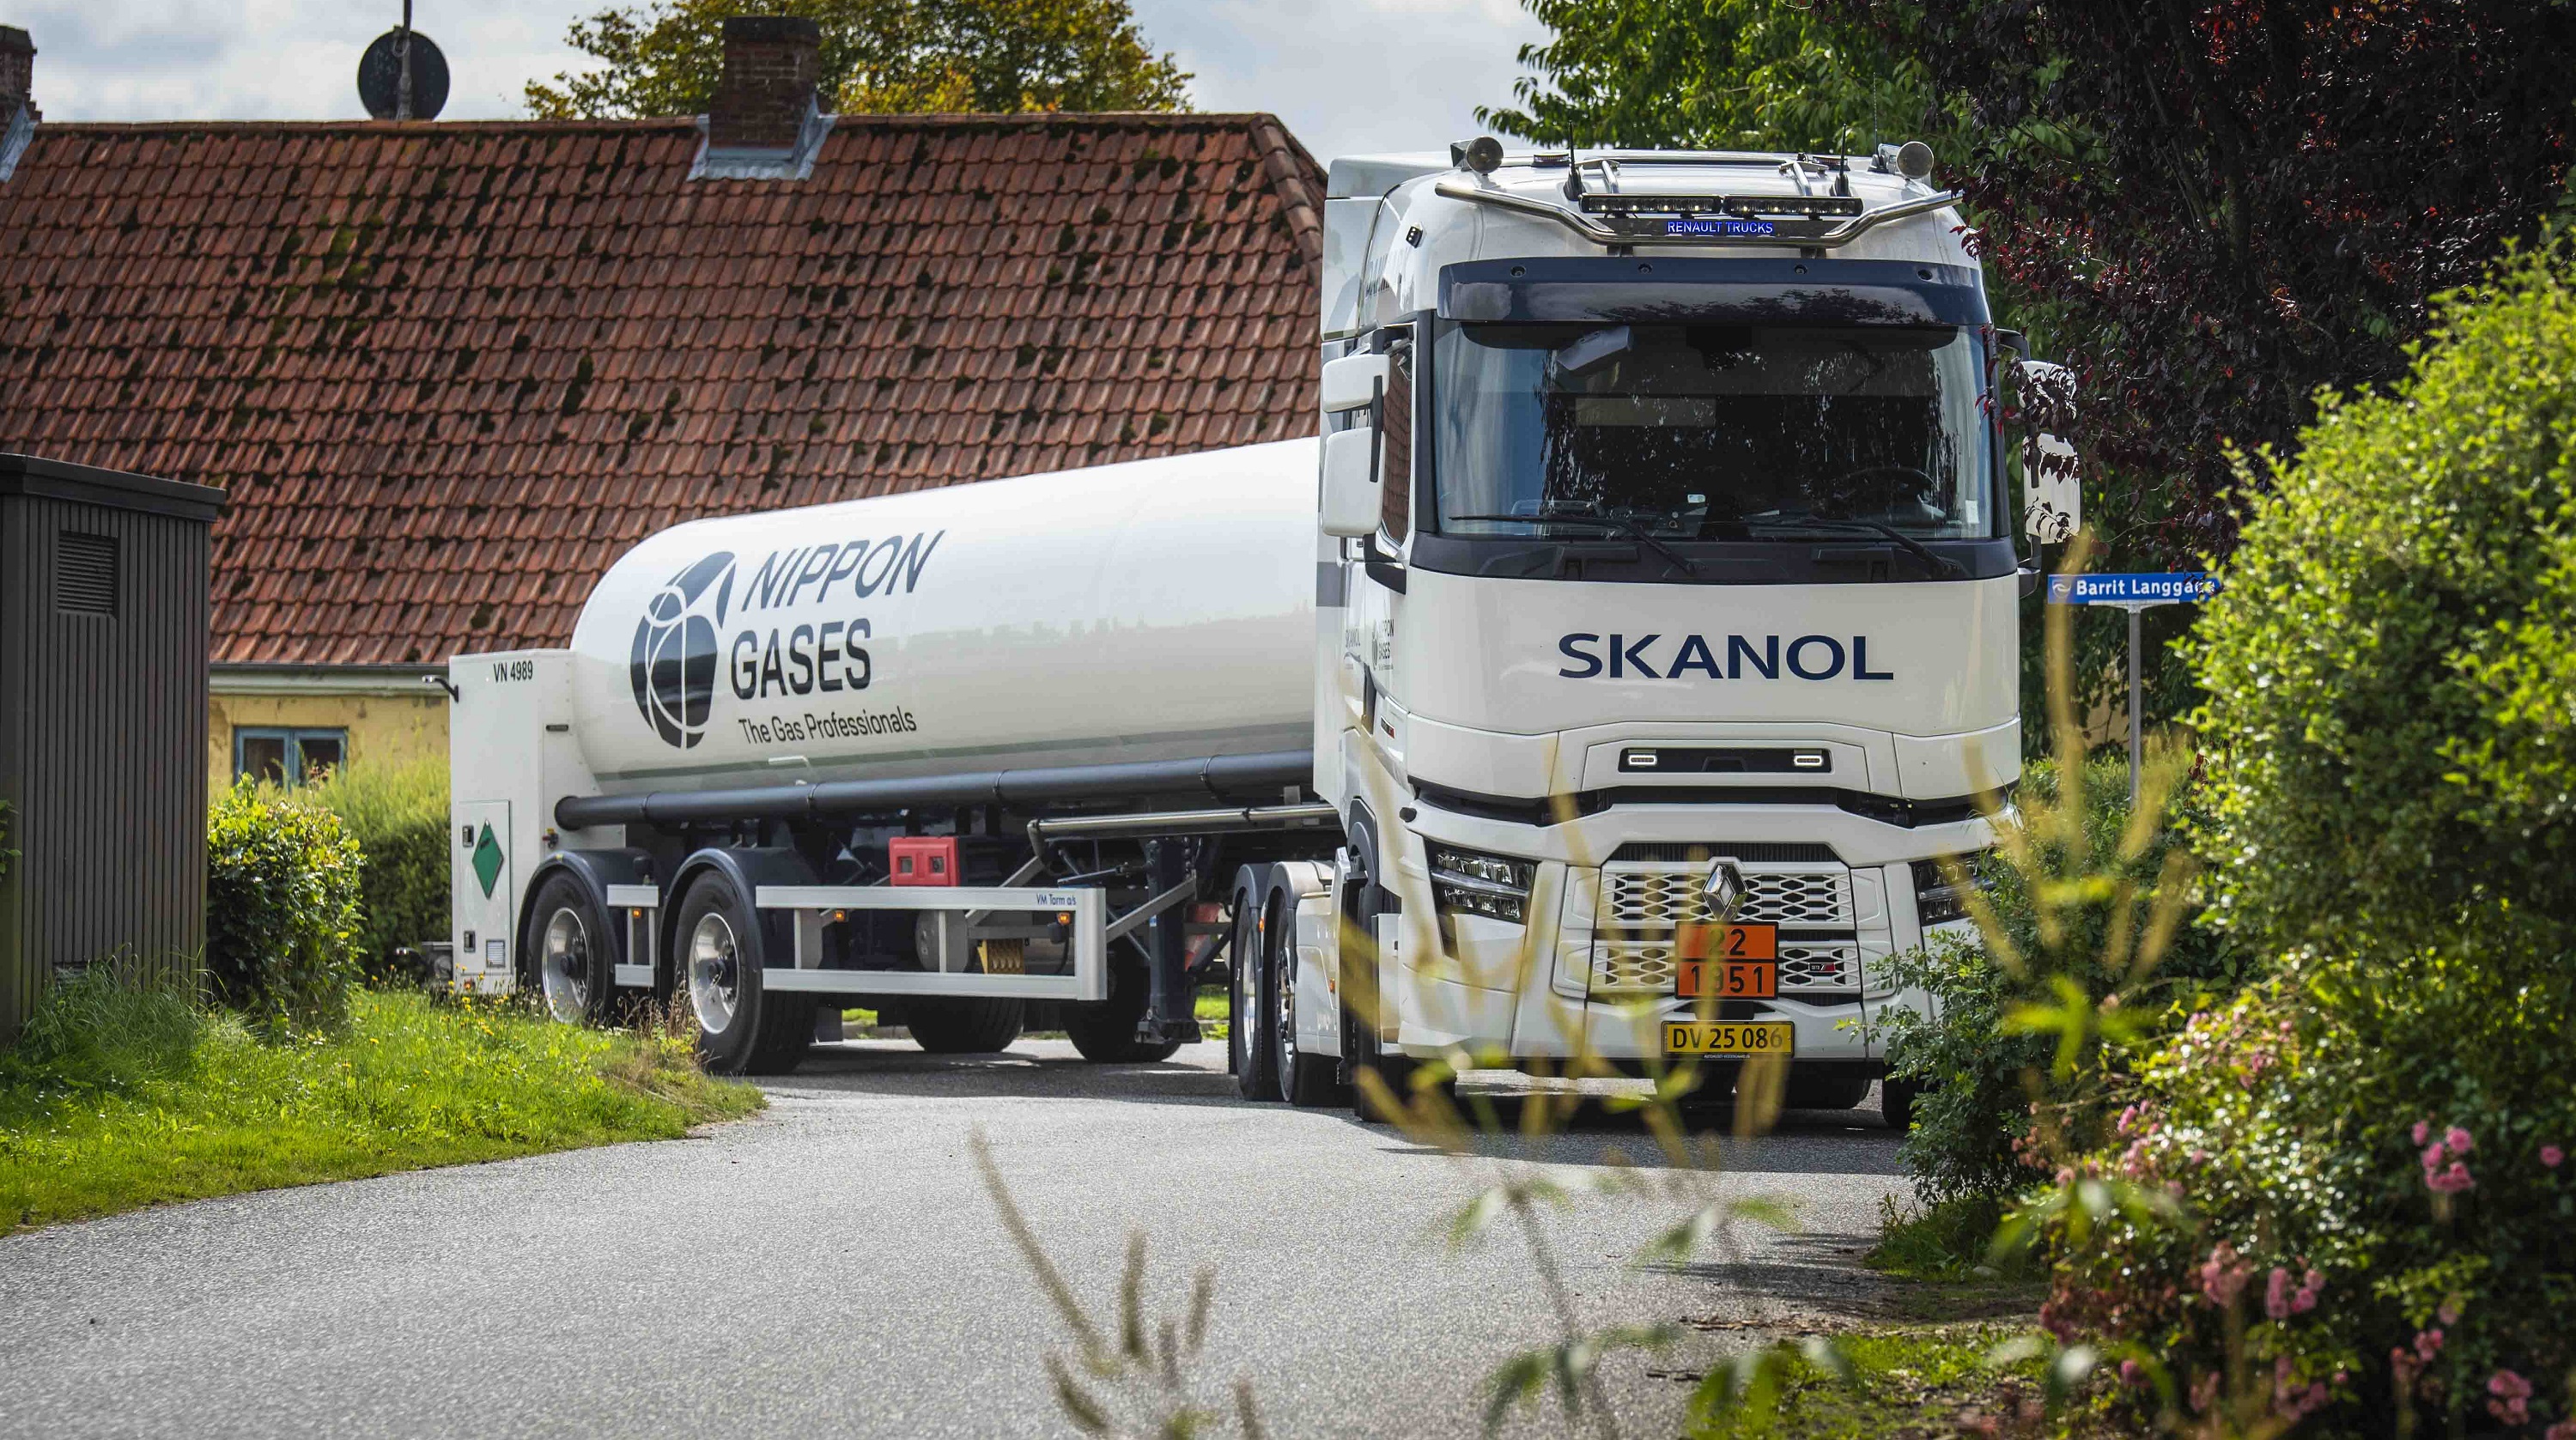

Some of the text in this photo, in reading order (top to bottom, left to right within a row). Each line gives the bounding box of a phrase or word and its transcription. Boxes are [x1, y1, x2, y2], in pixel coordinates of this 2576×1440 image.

[1668, 221, 1773, 234] RENAULT TRUCKS
[741, 530, 945, 612] NIPPON
[2076, 580, 2125, 595] Barrit
[493, 660, 533, 683] VN 4989
[731, 618, 872, 701] GASES
[1558, 633, 1894, 681] SKANOL
[738, 705, 918, 744] The Gas Professionals
[1036, 893, 1048, 906] VM
[1708, 927, 1747, 957] 22
[1691, 964, 1763, 994] 1951
[1673, 1026, 1783, 1049] DV 25 086
